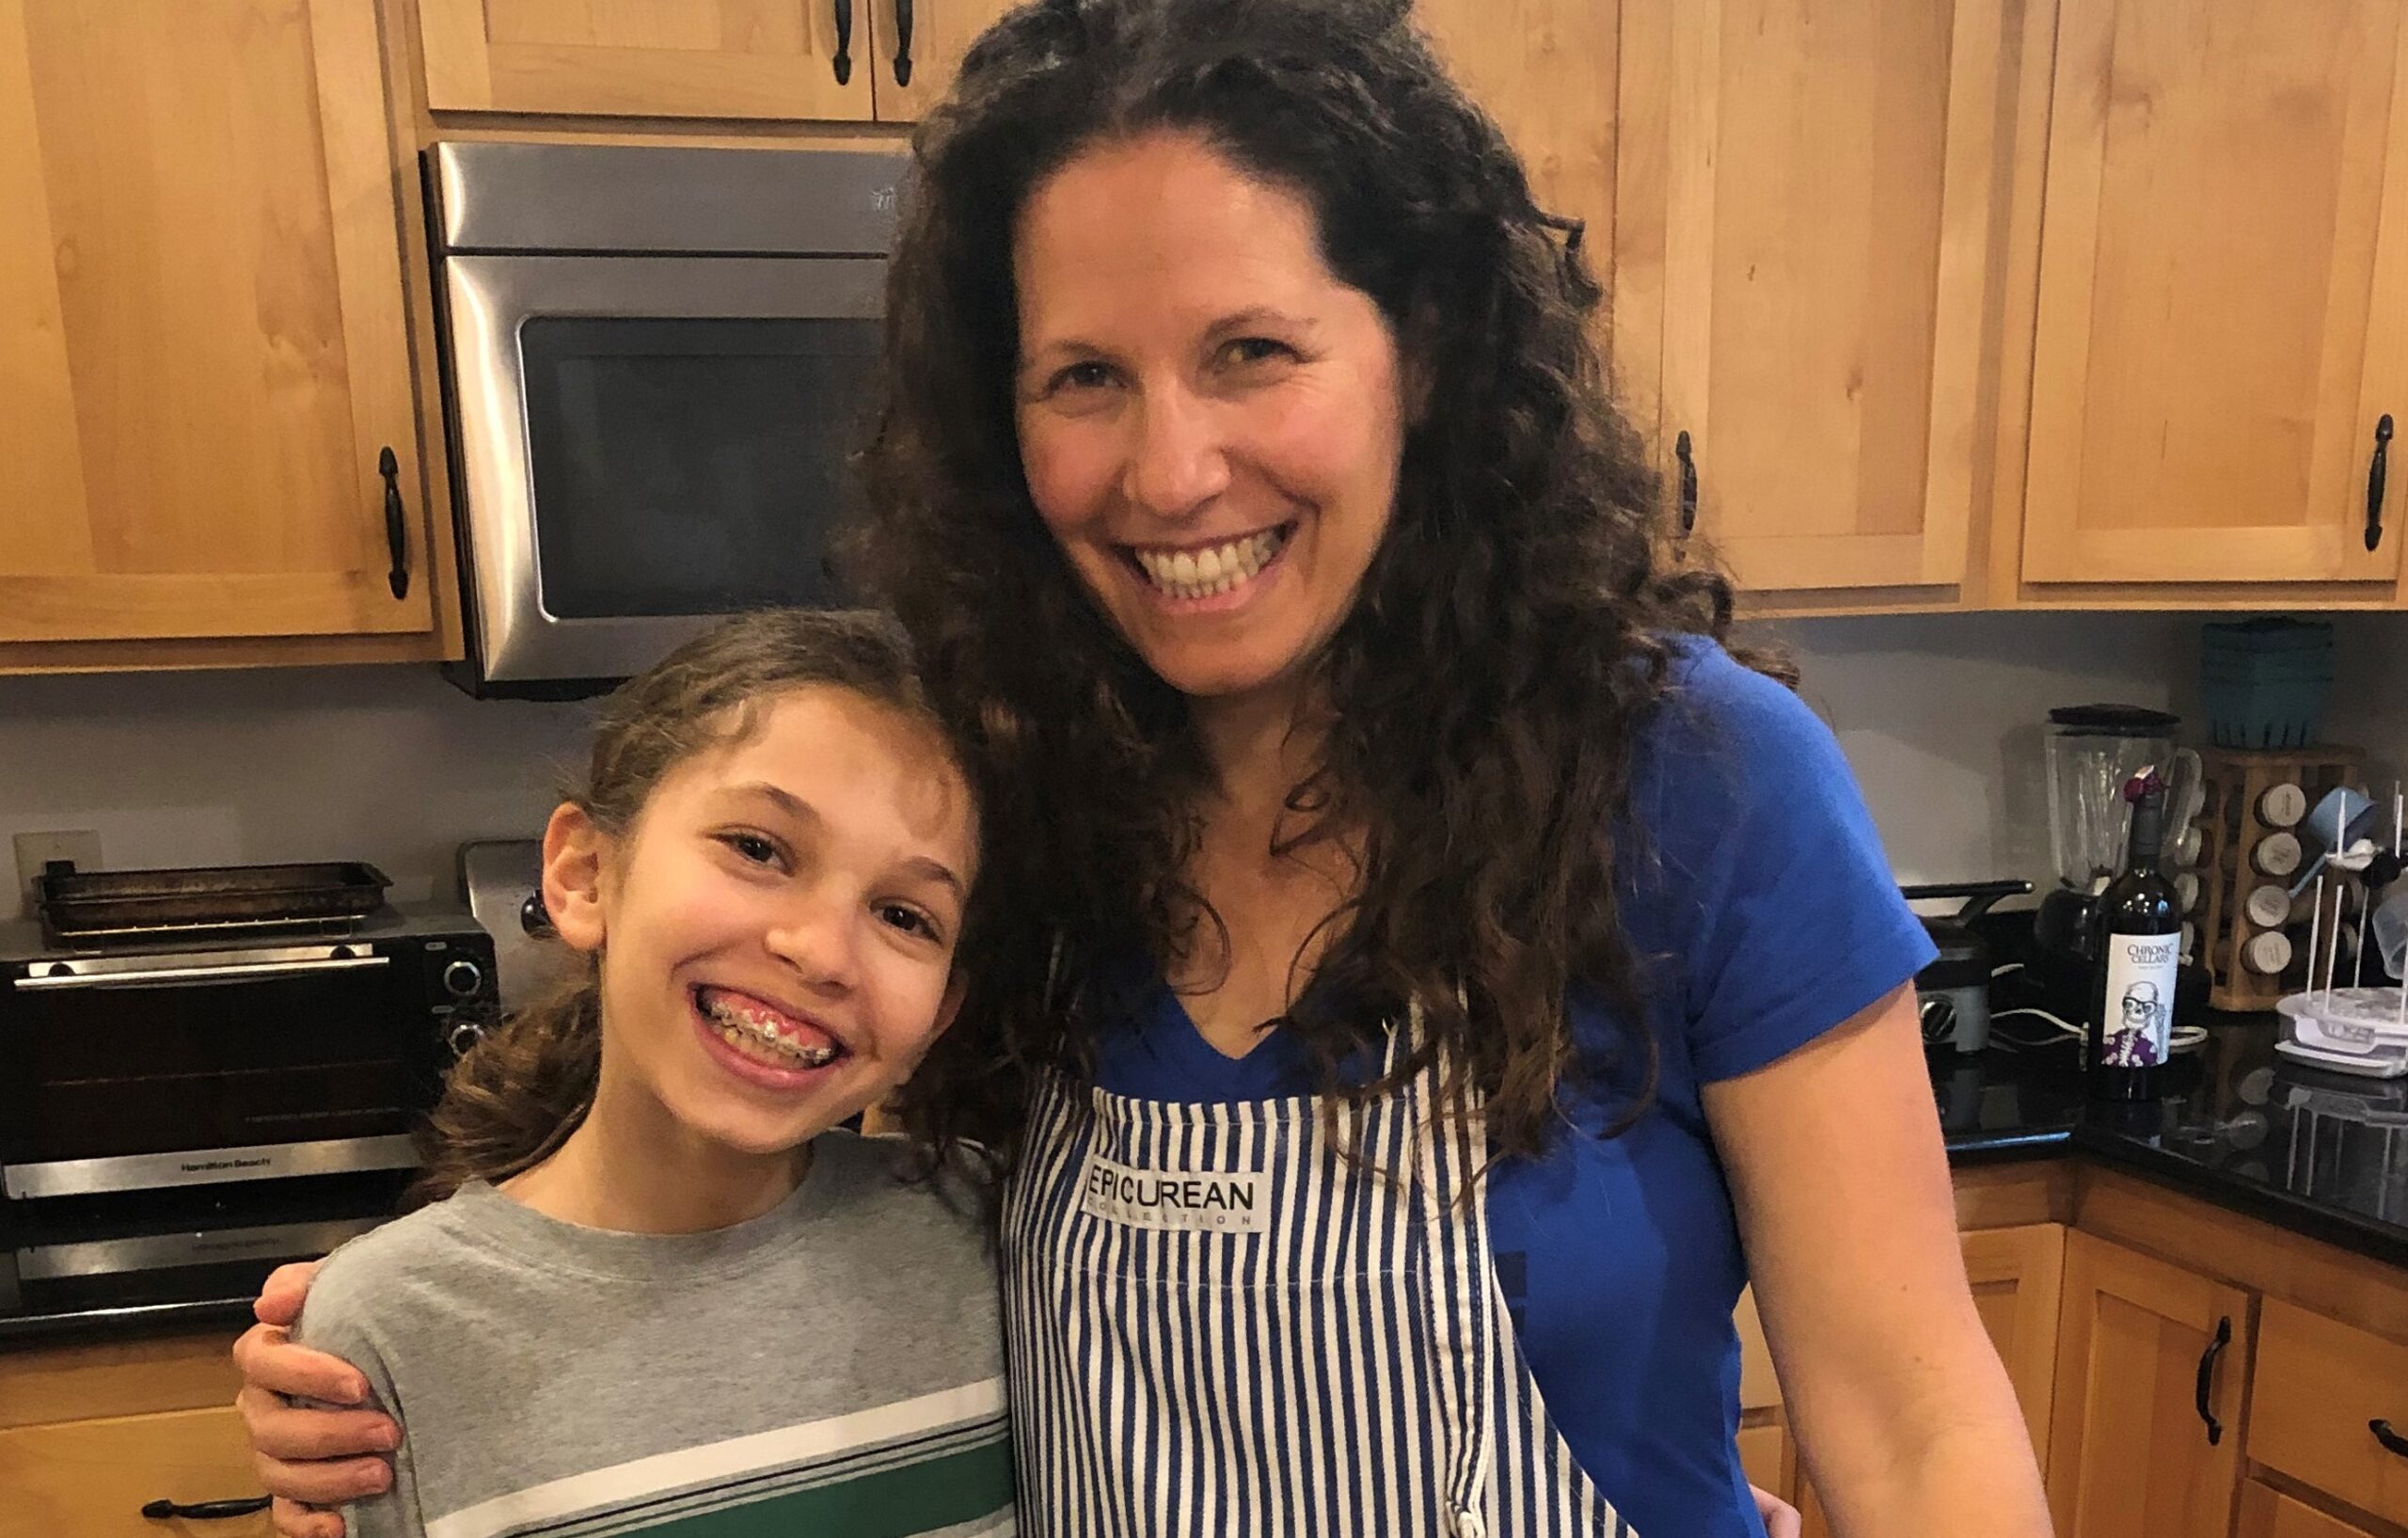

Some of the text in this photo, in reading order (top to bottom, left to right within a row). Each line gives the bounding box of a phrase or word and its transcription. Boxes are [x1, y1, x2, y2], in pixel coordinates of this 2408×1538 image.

[2127, 943, 2174, 956] CHRONIC
[181, 1161, 232, 1172] Hamilton
[1088, 1165, 1254, 1210] EPICUREAN
